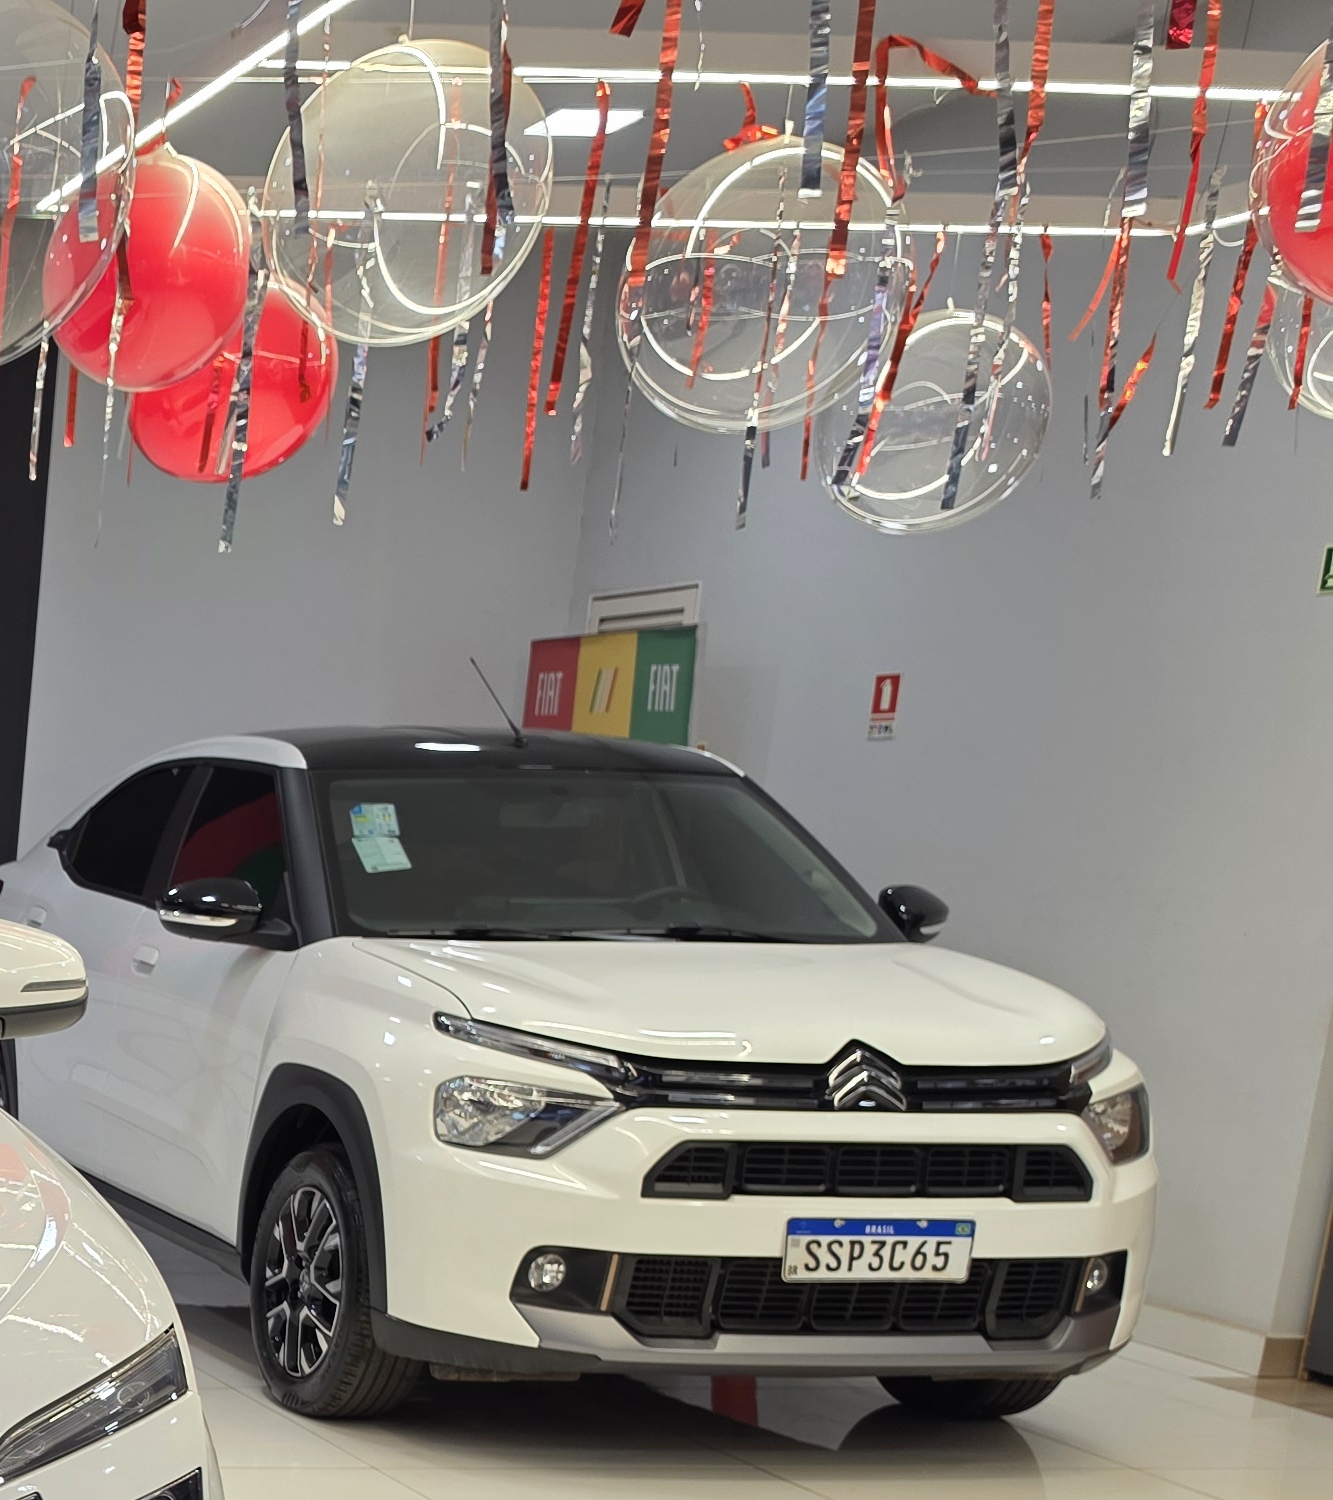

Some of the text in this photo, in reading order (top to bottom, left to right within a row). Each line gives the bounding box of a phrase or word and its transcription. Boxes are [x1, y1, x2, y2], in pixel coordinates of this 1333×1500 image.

[535, 671, 563, 717] FIAT
[647, 664, 680, 713] FIAT
[865, 1225, 895, 1235] BRASIL
[804, 1240, 952, 1273] SSP3C65
